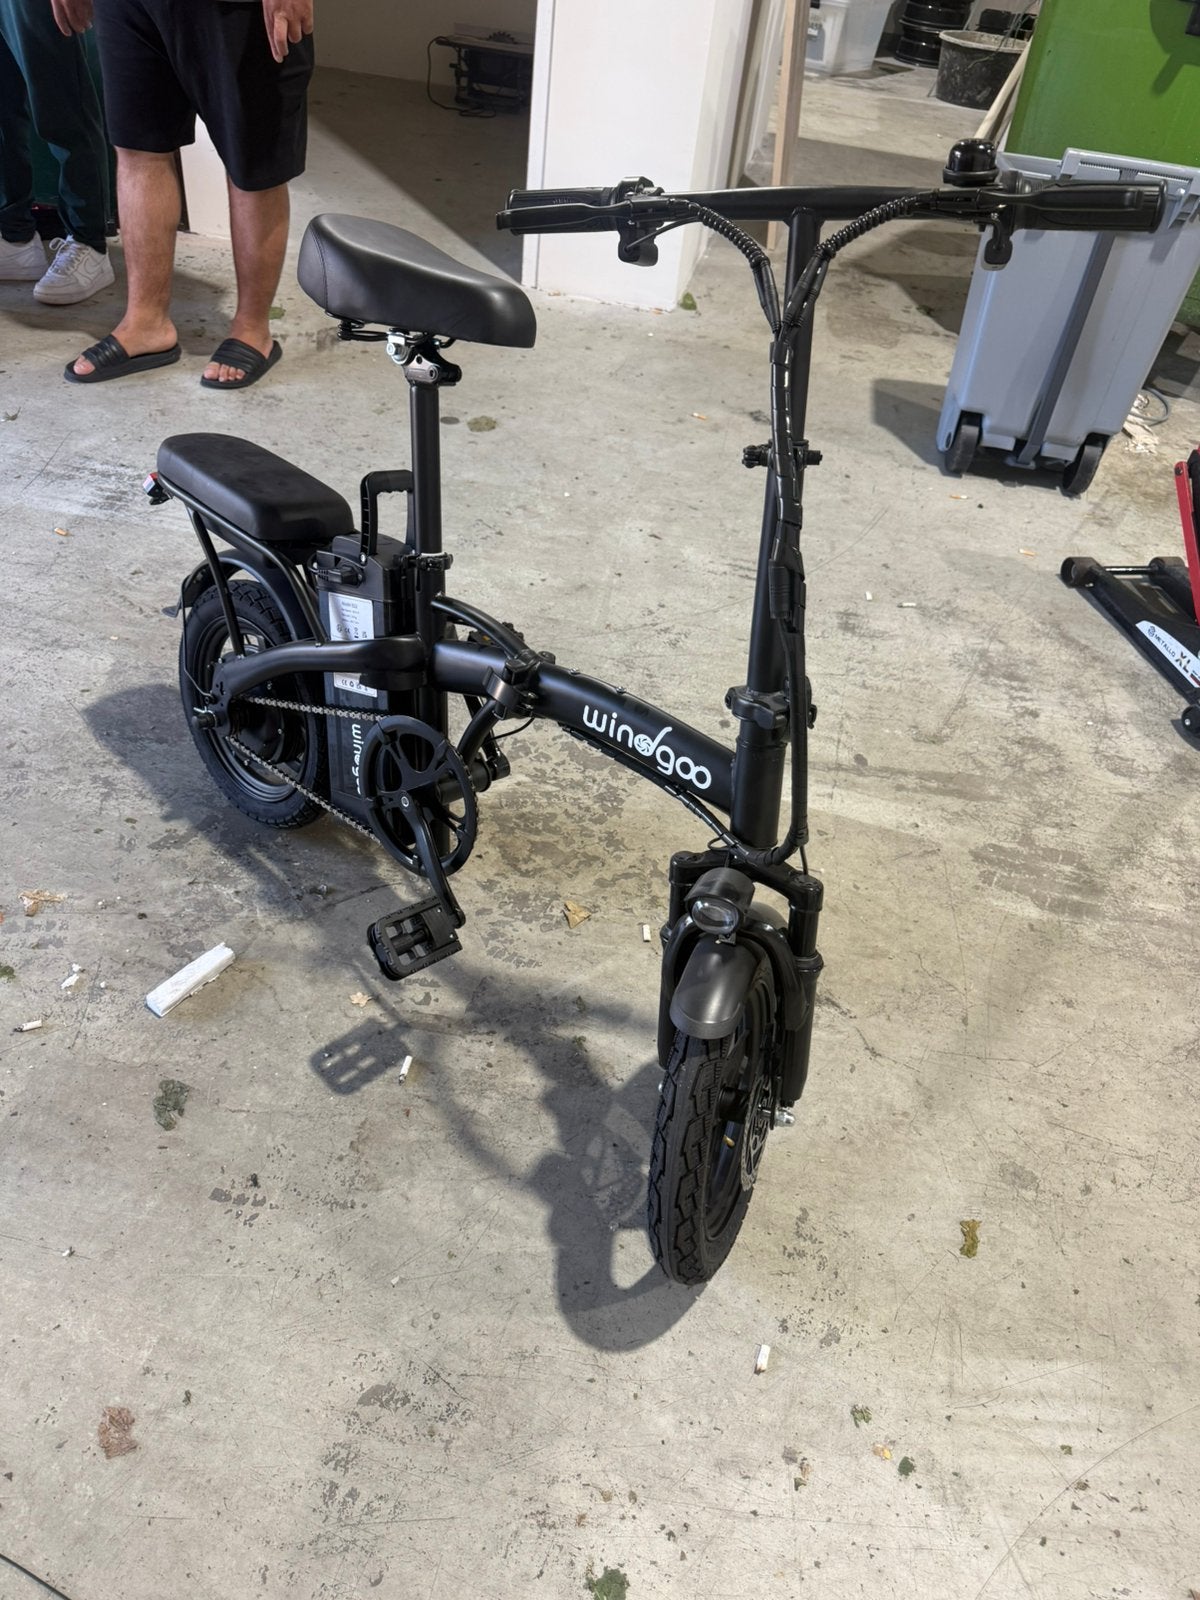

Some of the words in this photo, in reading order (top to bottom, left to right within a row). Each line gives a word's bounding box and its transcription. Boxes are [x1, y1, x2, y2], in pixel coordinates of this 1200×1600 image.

[1154, 634, 1176, 658] METALLO
[1175, 651, 1191, 673] XL
[582, 704, 712, 790] windgoo
